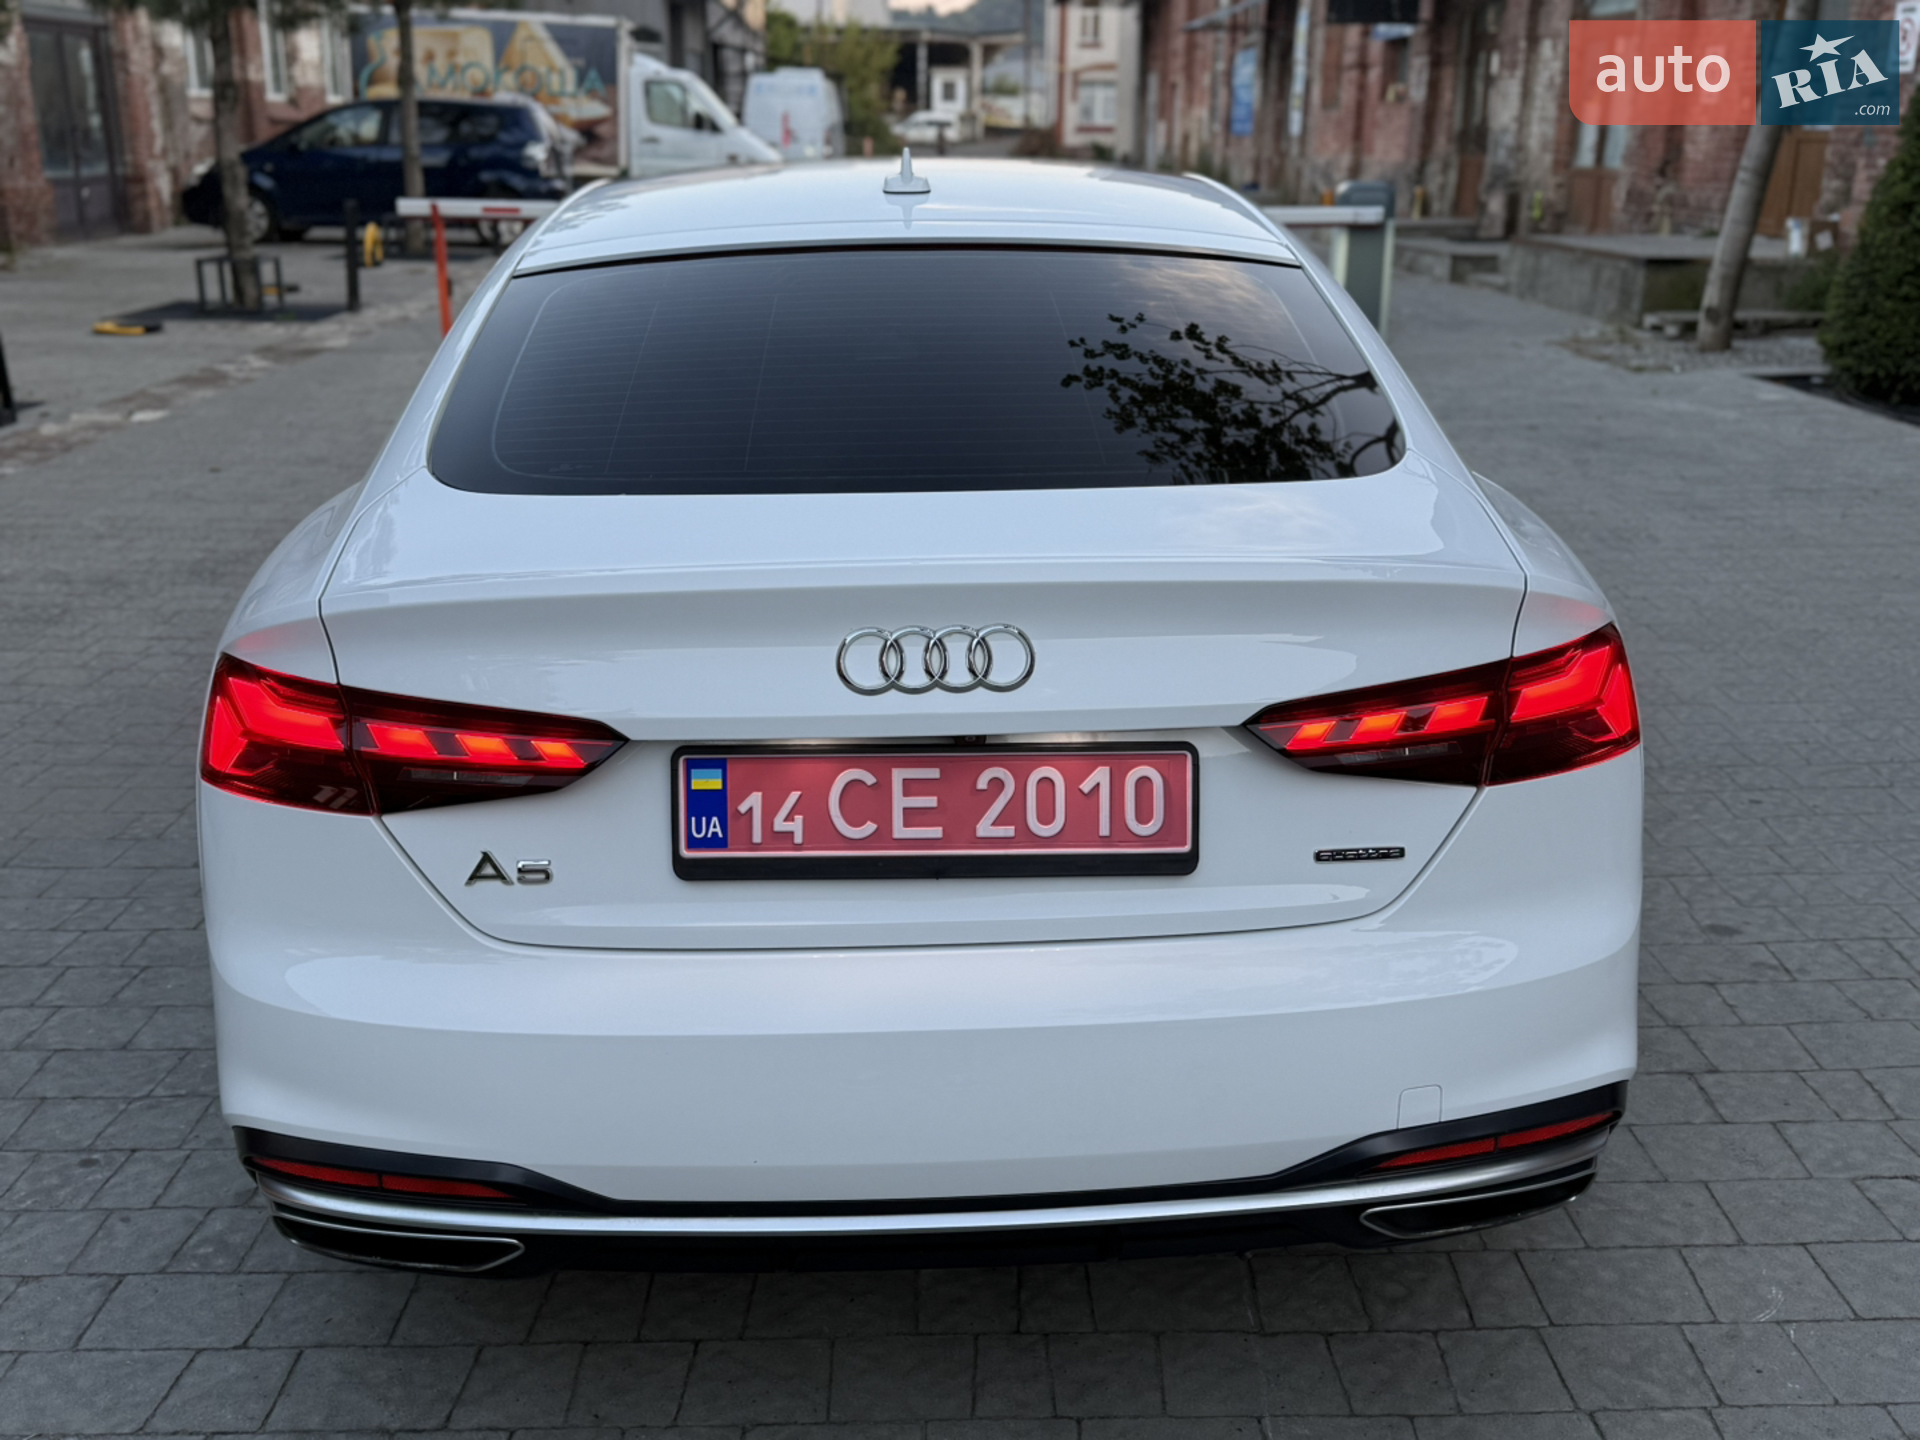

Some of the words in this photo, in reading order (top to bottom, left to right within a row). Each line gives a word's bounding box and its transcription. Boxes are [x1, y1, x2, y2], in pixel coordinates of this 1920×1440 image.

[736, 791, 804, 845] 14
[827, 767, 944, 840] CE
[974, 765, 1165, 839] 2010
[690, 815, 723, 839] UA
[464, 849, 554, 887] A5
[1318, 848, 1400, 861] quattro
